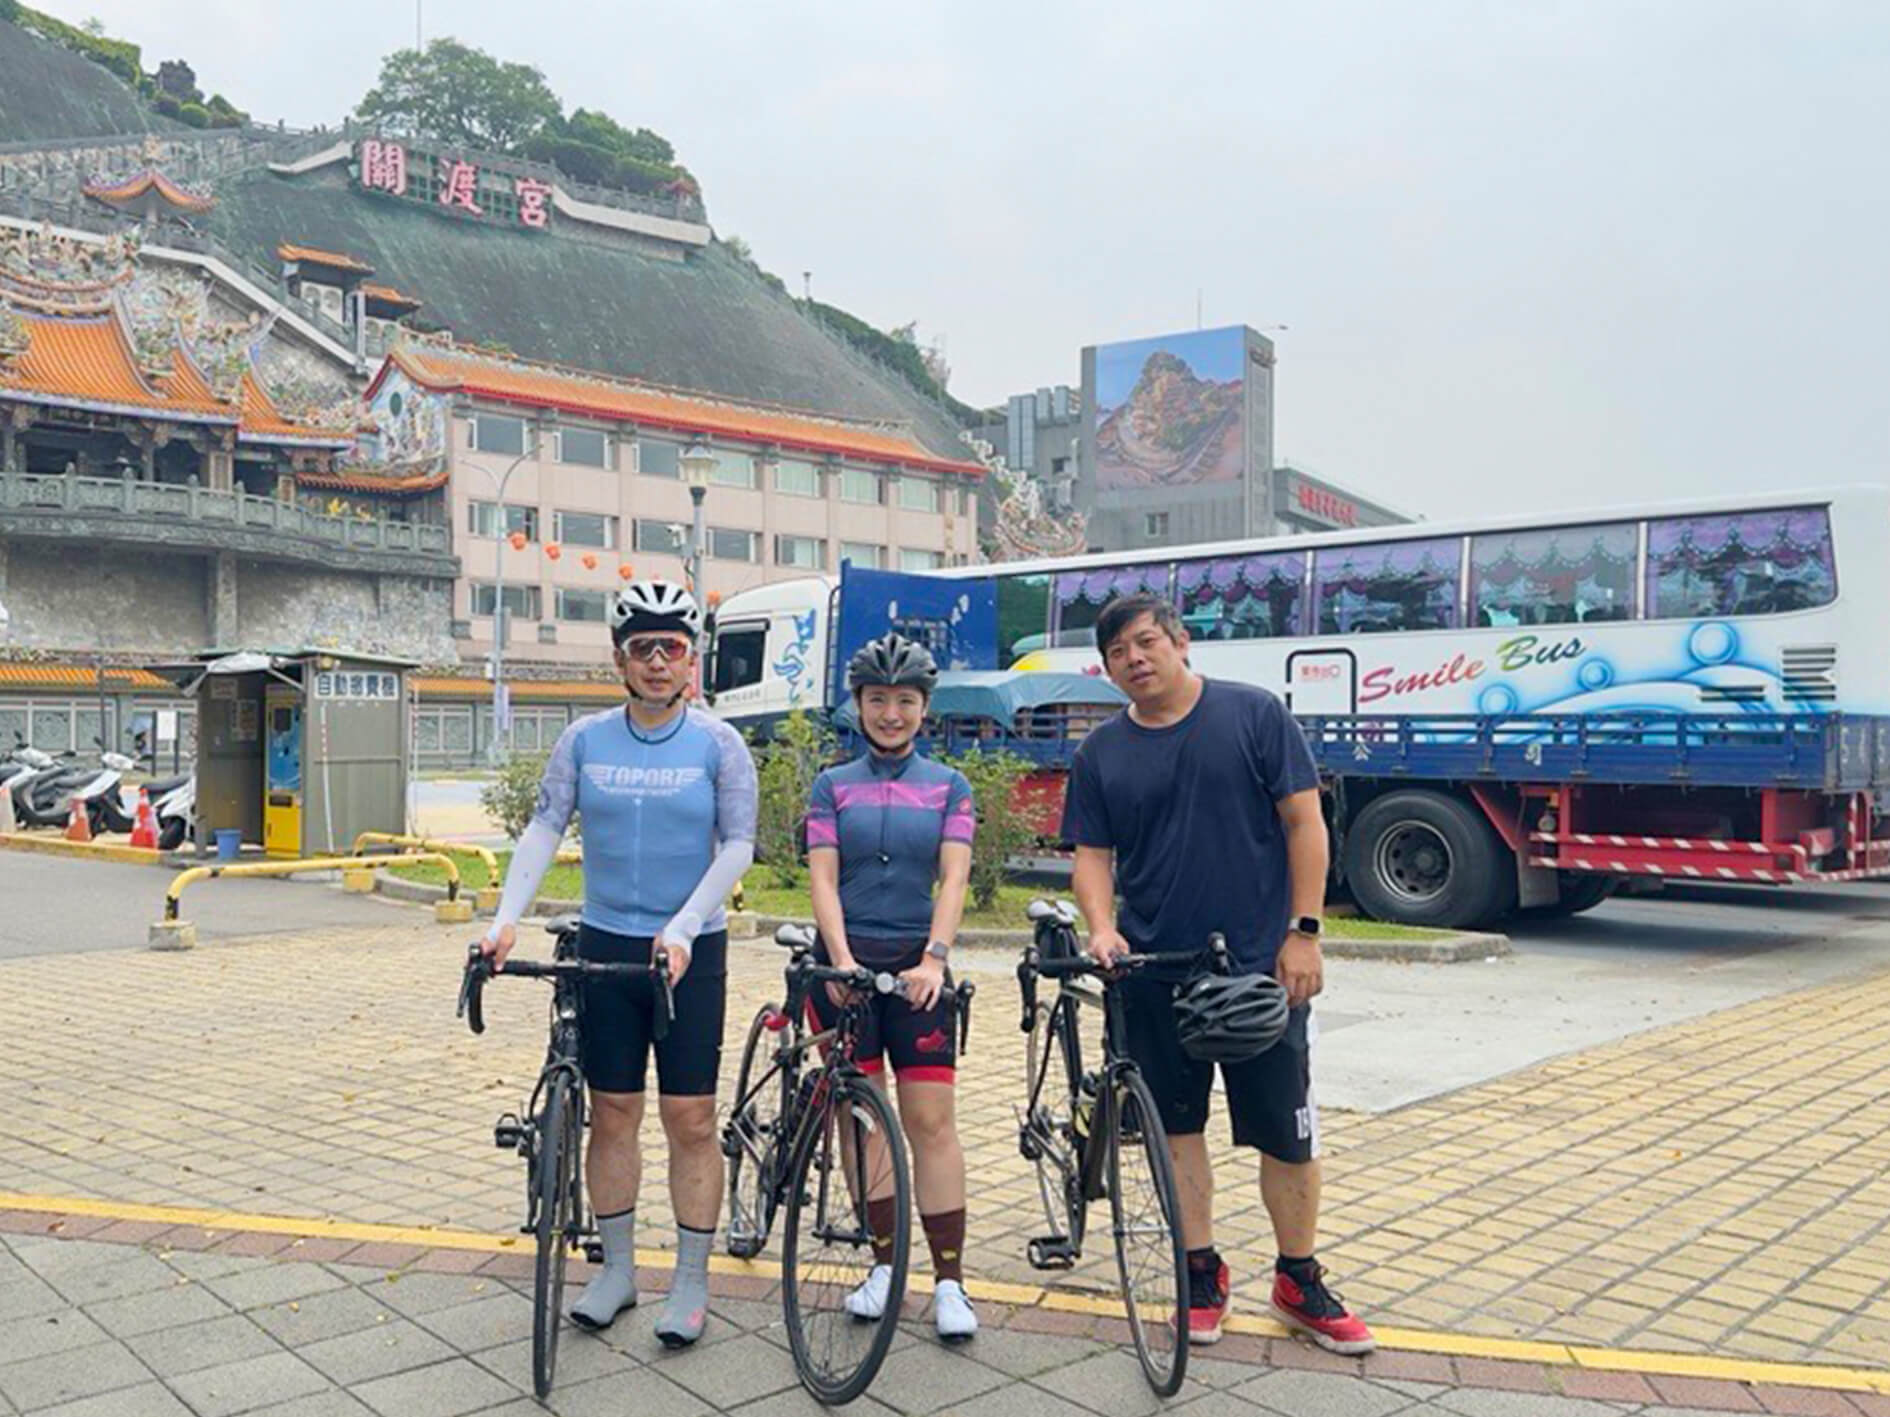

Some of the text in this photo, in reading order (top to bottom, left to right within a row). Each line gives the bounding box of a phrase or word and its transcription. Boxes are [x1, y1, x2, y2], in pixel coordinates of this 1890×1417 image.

[362, 139, 551, 228] 關渡宮
[1359, 635, 1586, 704] Smile Bus
